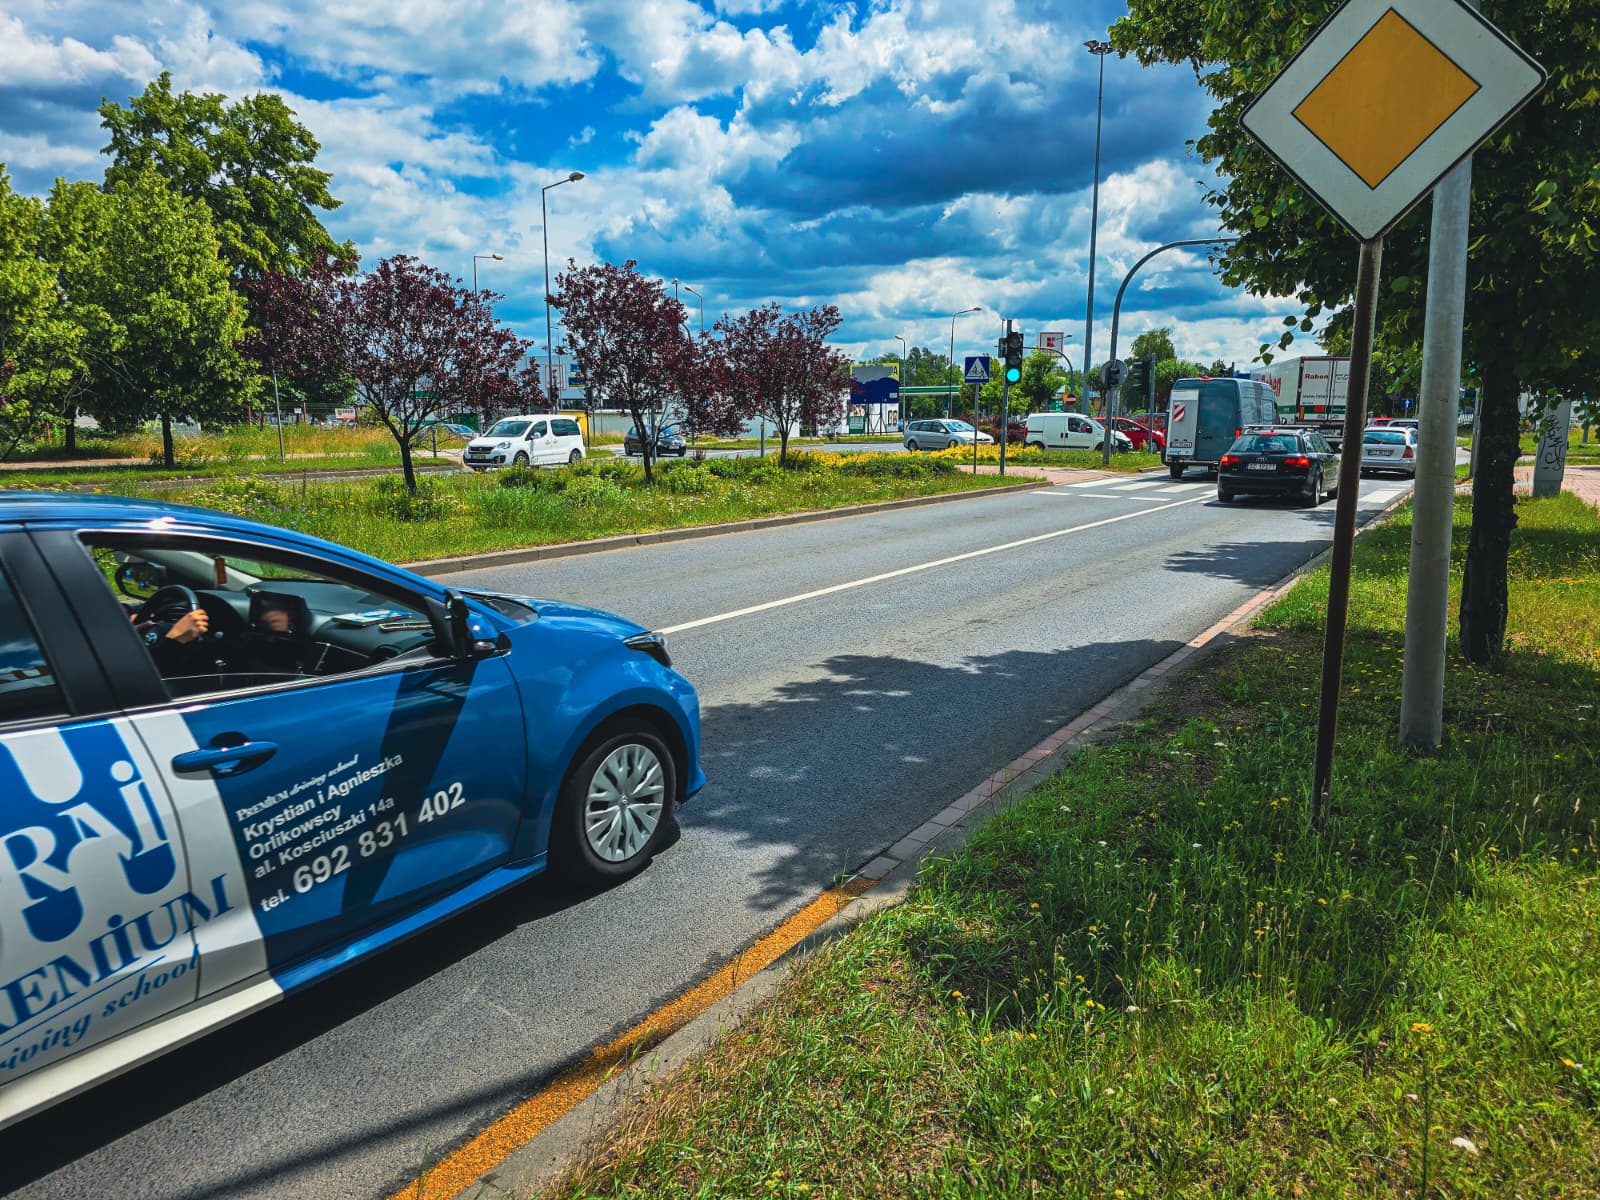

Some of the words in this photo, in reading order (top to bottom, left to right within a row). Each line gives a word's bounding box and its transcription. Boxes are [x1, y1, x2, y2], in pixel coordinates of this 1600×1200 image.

[242, 798, 316, 842] Krystian
[316, 790, 325, 805] i
[327, 754, 404, 800] Agnieszka
[289, 773, 327, 796] driving
[328, 753, 359, 777] school
[249, 804, 342, 859] Orlikowscy
[254, 857, 277, 879] al.
[278, 809, 366, 866] Kosciuszki
[368, 796, 395, 817] 14a
[260, 888, 290, 912] tel.
[293, 844, 352, 894] 692
[358, 812, 408, 858] 831
[417, 782, 466, 824] 402
[102, 943, 199, 1017] school
